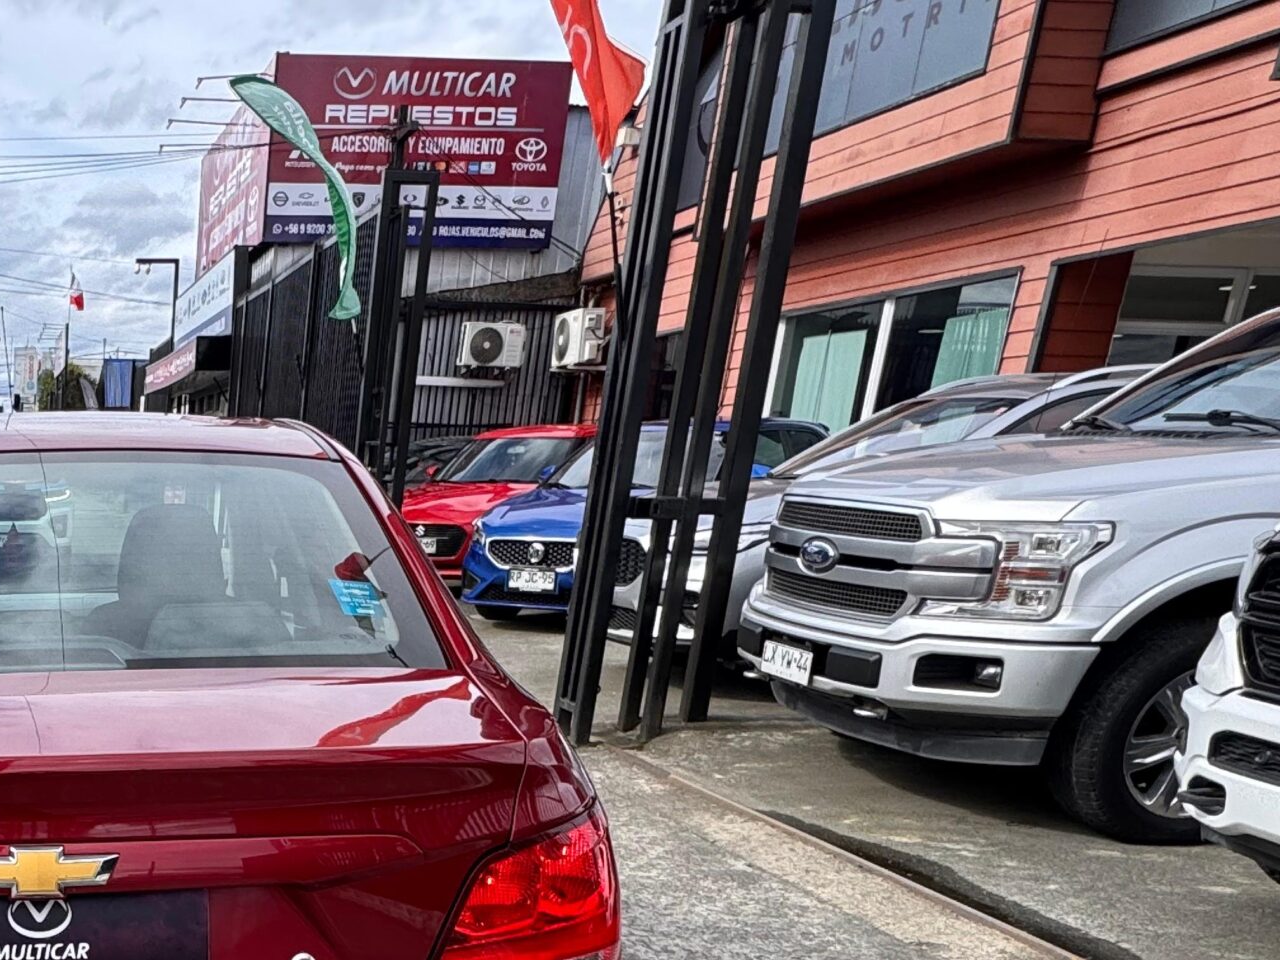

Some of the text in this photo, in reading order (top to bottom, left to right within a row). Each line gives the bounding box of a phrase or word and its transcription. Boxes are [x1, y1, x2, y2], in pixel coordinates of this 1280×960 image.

[382, 71, 517, 98] MULTICAR
[324, 104, 518, 127] REPUESTOS
[408, 138, 416, 154] Y
[418, 137, 505, 155] EQUIPAMIENTO
[511, 162, 547, 172] TOYOTA
[510, 571, 522, 583] RP
[763, 645, 779, 667] LX
